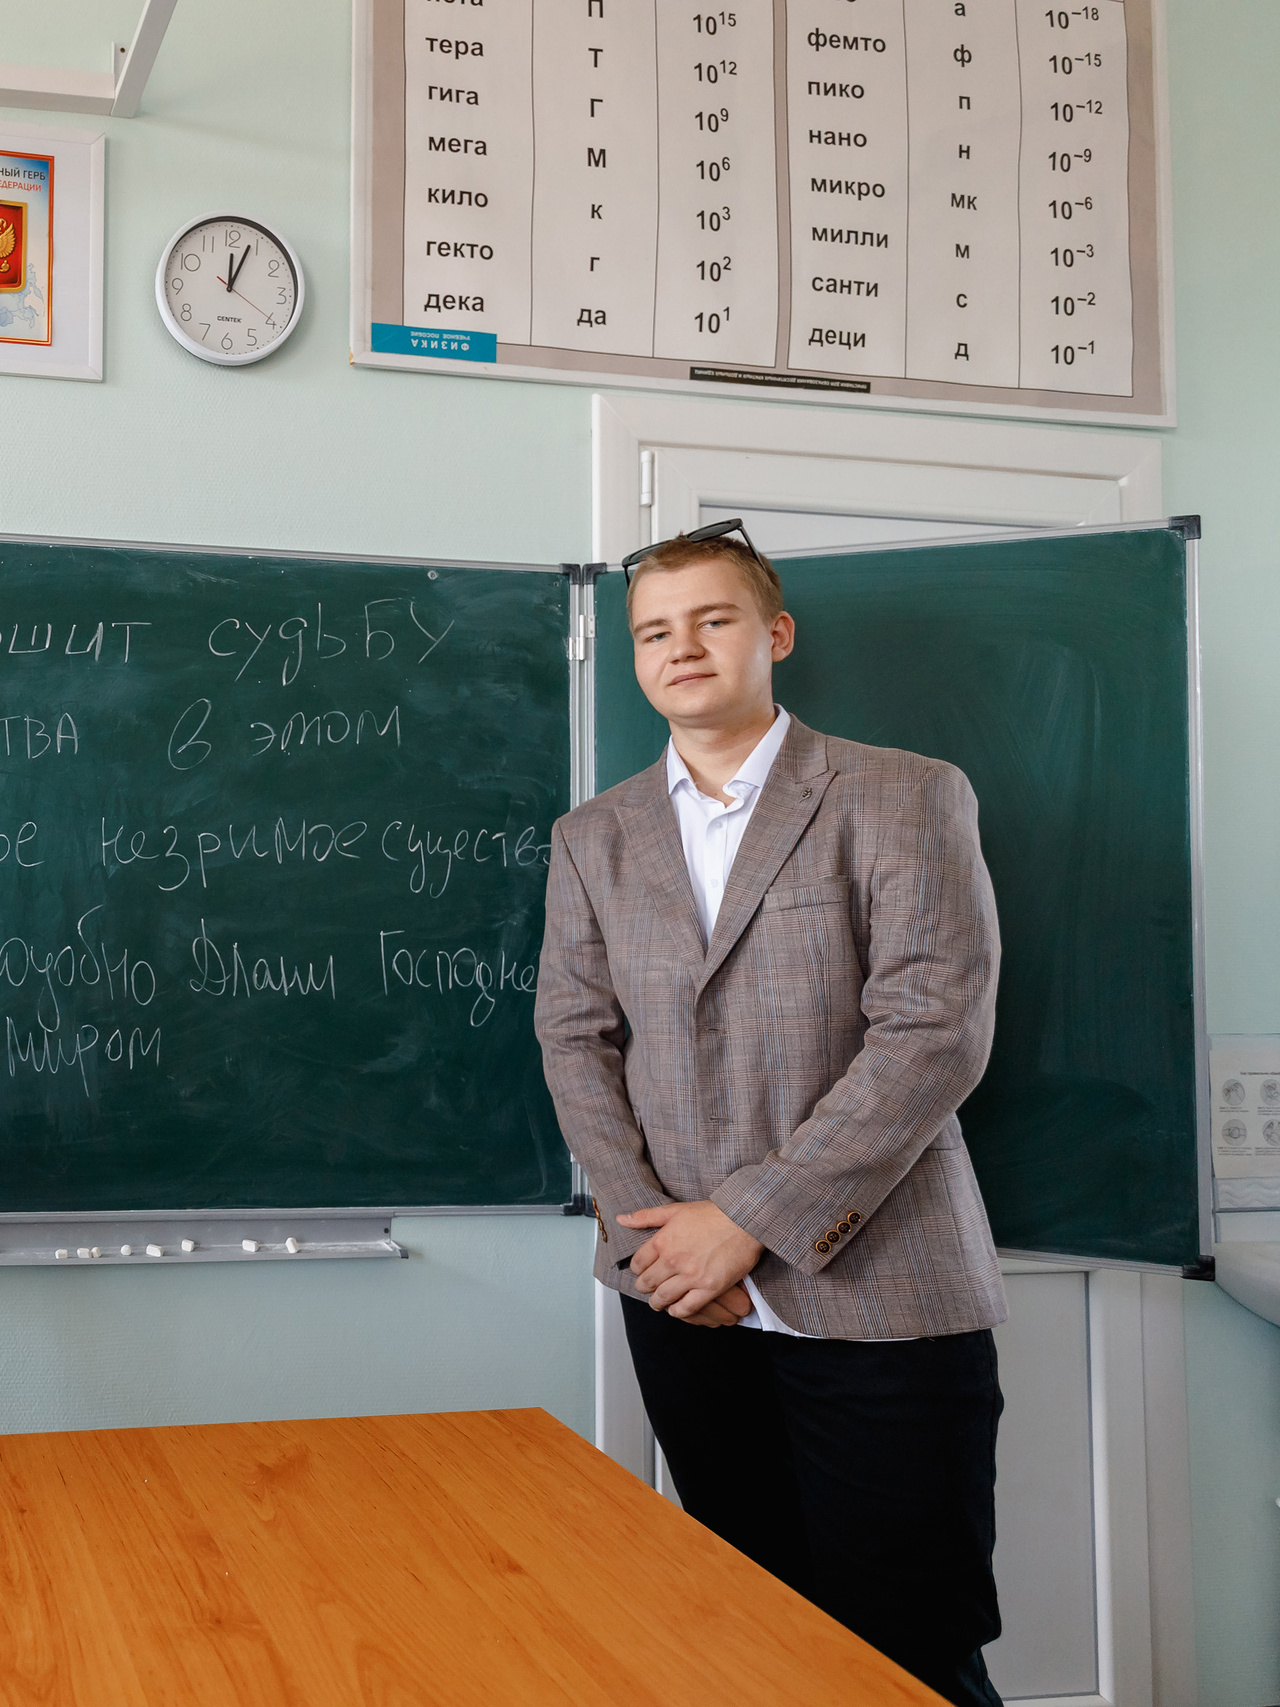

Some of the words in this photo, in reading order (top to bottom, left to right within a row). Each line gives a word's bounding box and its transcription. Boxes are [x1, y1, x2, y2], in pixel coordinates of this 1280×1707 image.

[425, 37, 484, 60] тера
[807, 27, 887, 53] фемто
[428, 85, 479, 106] гига
[807, 81, 865, 100] пико
[428, 136, 488, 156] мега
[808, 129, 868, 148] нано
[23, 170, 46, 181] ГЕРБ
[427, 187, 489, 208] кило
[810, 177, 886, 202] микро
[950, 192, 978, 211] мк
[202, 235, 215, 253] 11
[225, 229, 241, 248] 12
[811, 226, 889, 249] милли
[426, 240, 494, 261] гекто
[180, 252, 201, 272] 10
[267, 259, 280, 278] 2
[171, 278, 184, 295] 9
[276, 286, 287, 305] 3
[811, 276, 879, 298] санти
[180, 303, 192, 321] 8
[423, 293, 485, 313] дека
[217, 315, 242, 323] CENTEK
[265, 312, 277, 330] 4
[576, 308, 607, 328] да
[199, 322, 211, 341] 7
[221, 332, 233, 350] 6
[246, 328, 257, 346] 5
[808, 327, 866, 351] деци
[410, 338, 470, 351] ФИЗИКА
[167, 698, 212, 770] в
[250, 705, 401, 757] этом
[379, 929, 538, 1028] Господне
